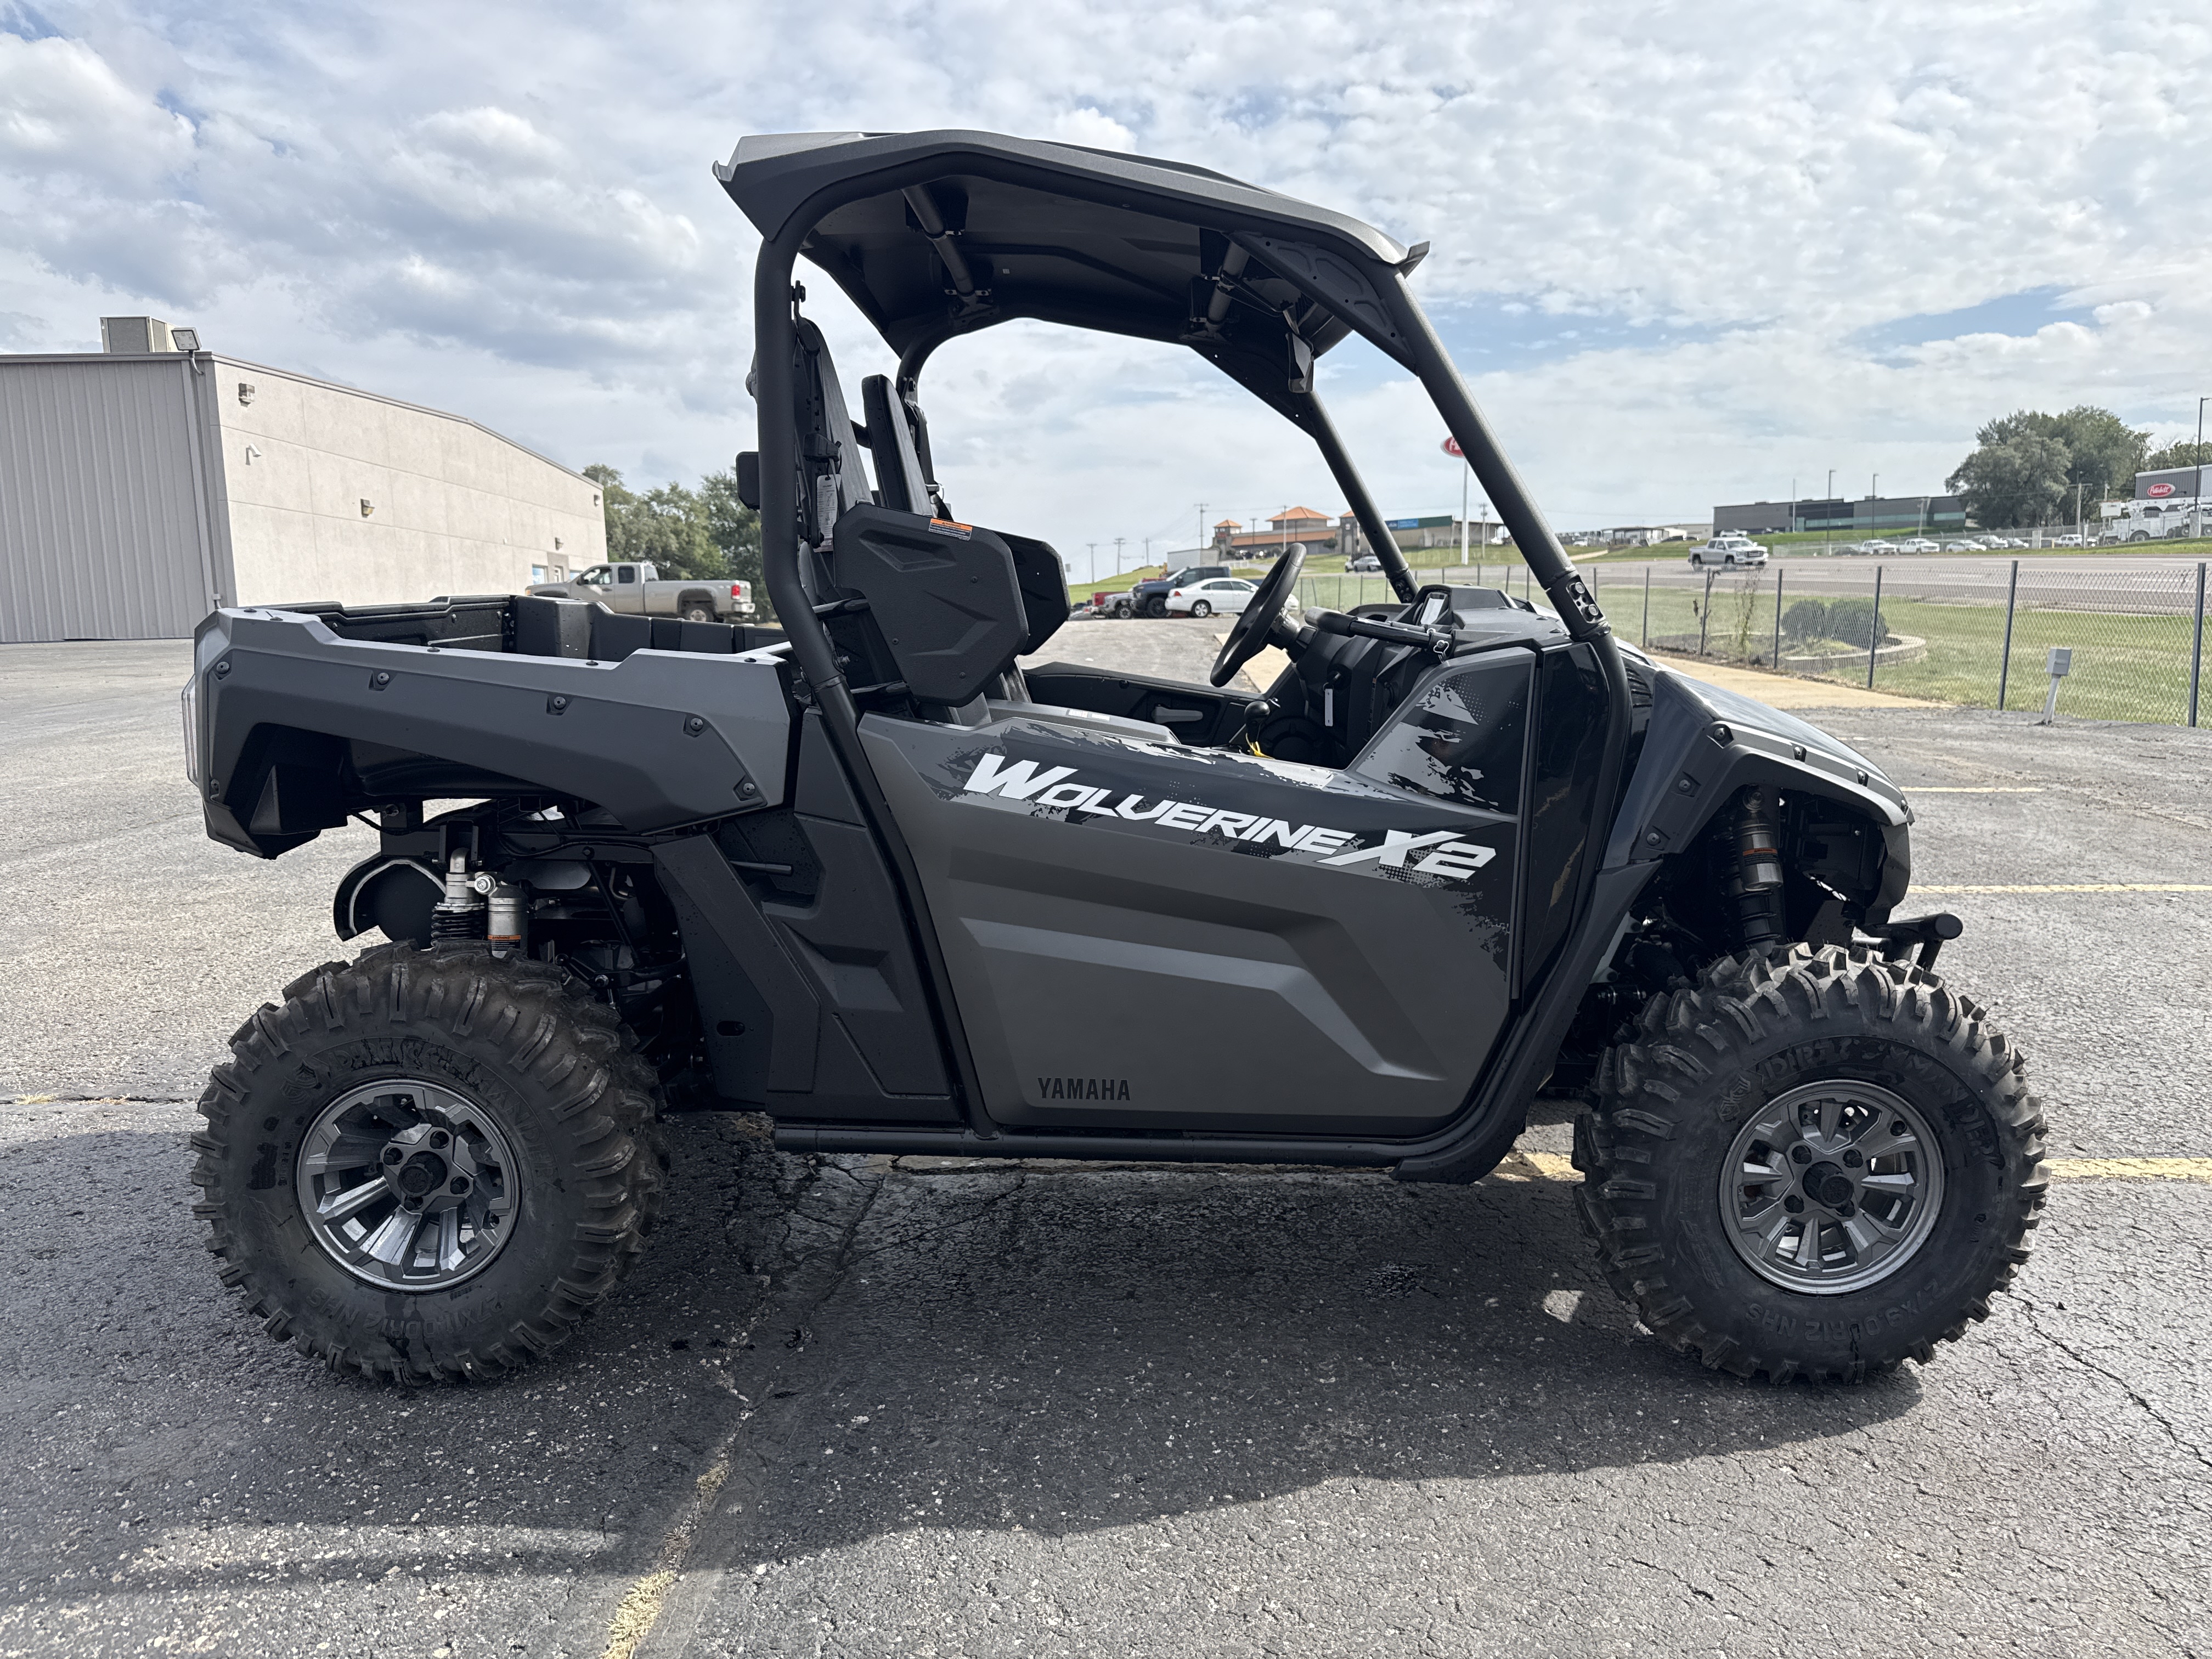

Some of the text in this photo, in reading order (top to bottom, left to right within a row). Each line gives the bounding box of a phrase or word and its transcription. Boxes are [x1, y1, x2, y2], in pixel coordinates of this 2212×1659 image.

[1314, 829, 1497, 879] X2
[1037, 1077, 1131, 1101] YAMAHA
[306, 1287, 360, 1328] NHS
[1745, 1302, 1798, 1338] NHS
